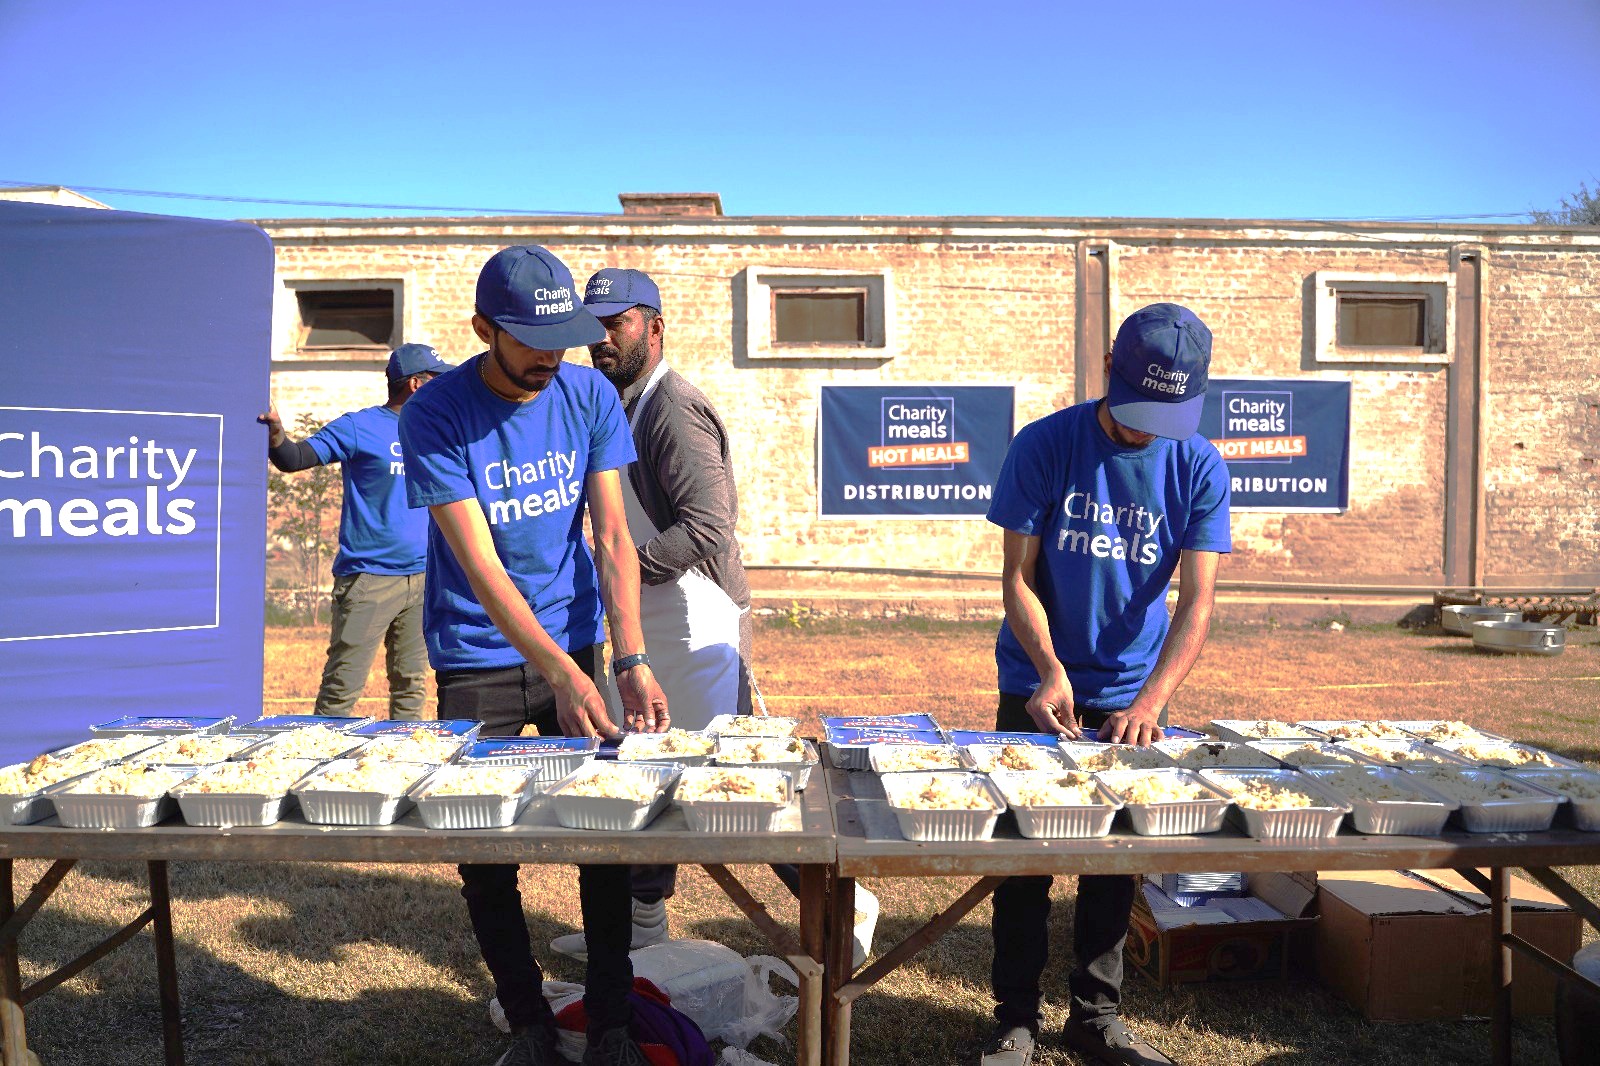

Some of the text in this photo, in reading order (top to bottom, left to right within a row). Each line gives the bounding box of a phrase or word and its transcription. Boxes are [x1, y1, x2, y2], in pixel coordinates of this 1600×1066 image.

[534, 286, 571, 301] Charity
[535, 298, 574, 316] meals
[1147, 363, 1190, 385] Charity
[1142, 376, 1187, 395] meals
[888, 404, 947, 424] Charity
[1228, 398, 1286, 418] Charity
[888, 421, 947, 439] meals
[1228, 414, 1286, 432] meals
[871, 445, 966, 464] HOT MEALS
[1250, 438, 1303, 455] MEALS
[0, 431, 198, 492] Charity
[484, 450, 577, 490] Charity
[843, 484, 992, 500] DISTRIBUTION
[1230, 477, 1328, 493] RIBUTION
[489, 477, 580, 525] meals
[0, 485, 197, 538] meals
[1064, 492, 1165, 539] Charity
[1057, 531, 1158, 565] meals
